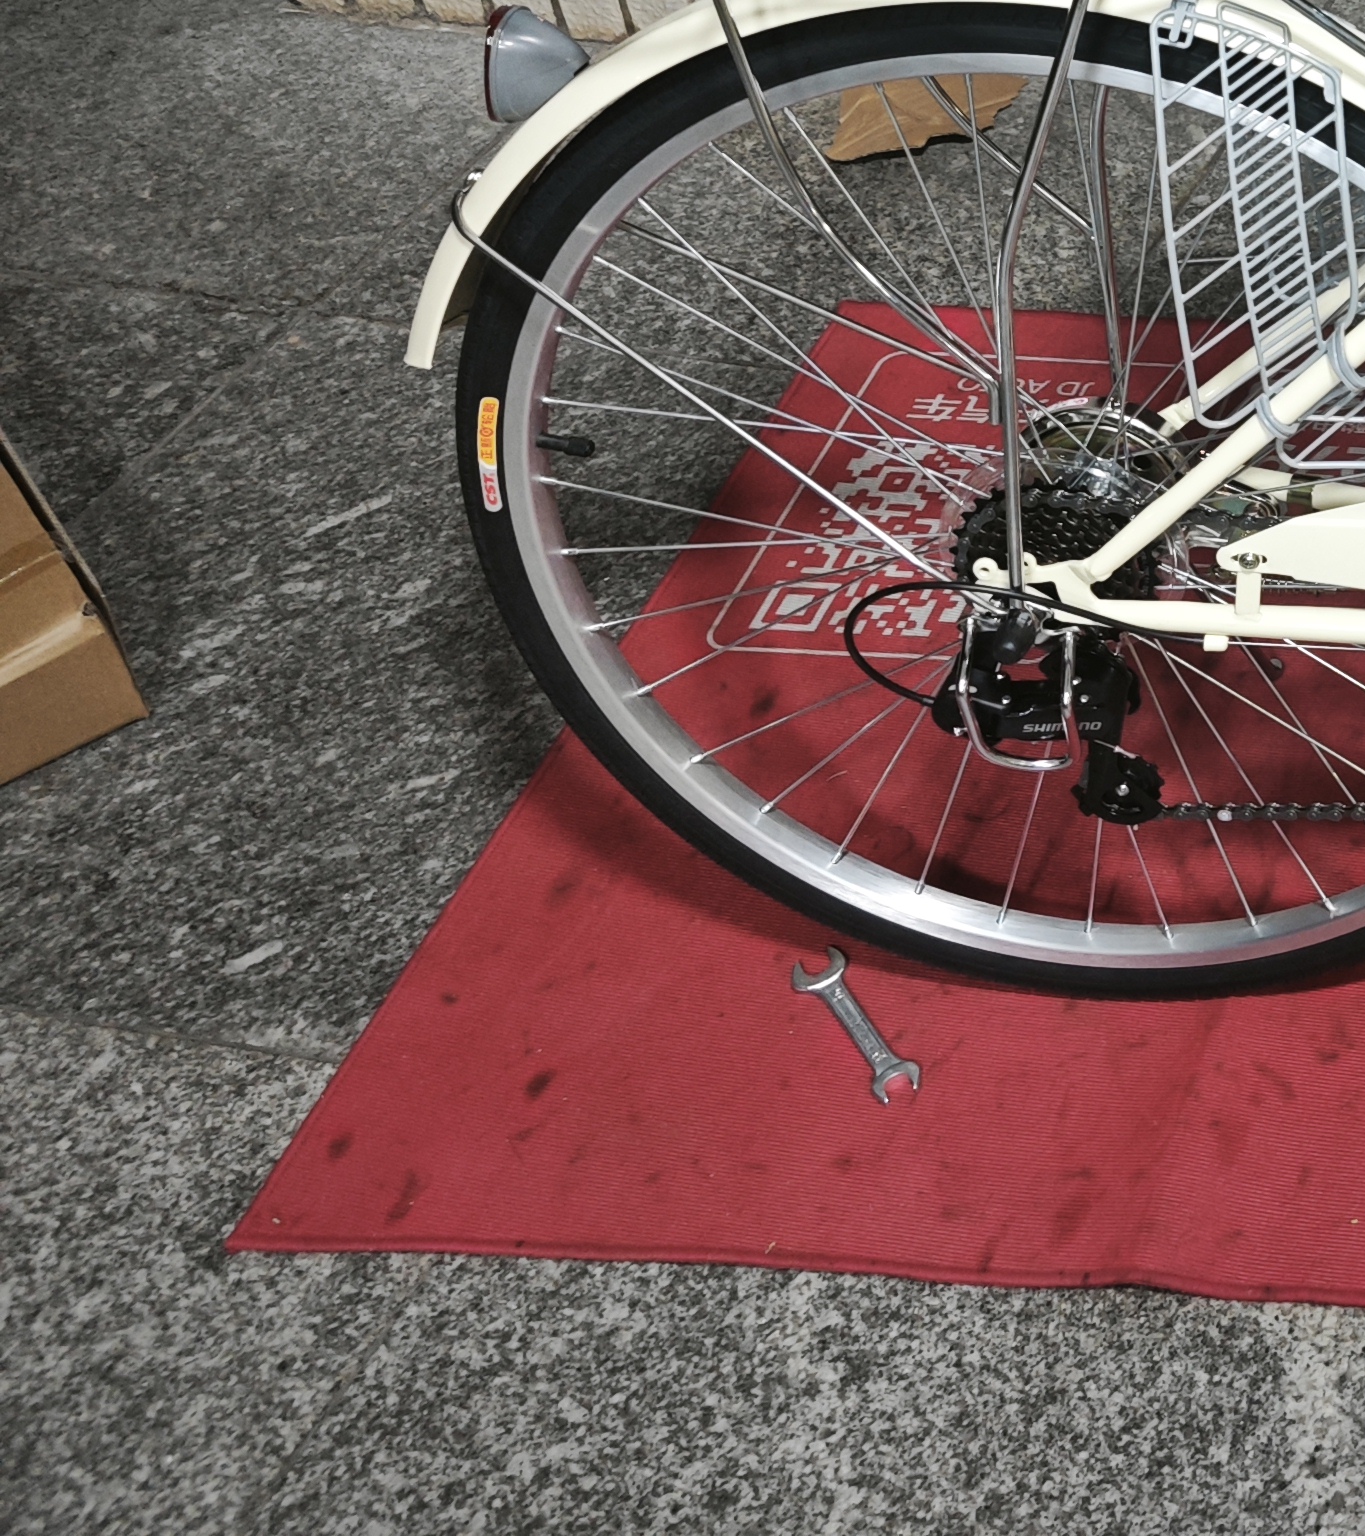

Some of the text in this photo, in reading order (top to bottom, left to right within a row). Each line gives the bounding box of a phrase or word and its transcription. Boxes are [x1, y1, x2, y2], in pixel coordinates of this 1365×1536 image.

[1056, 380, 1096, 397] JD
[482, 473, 498, 506] CST
[1021, 721, 1103, 734] SHIMNO
